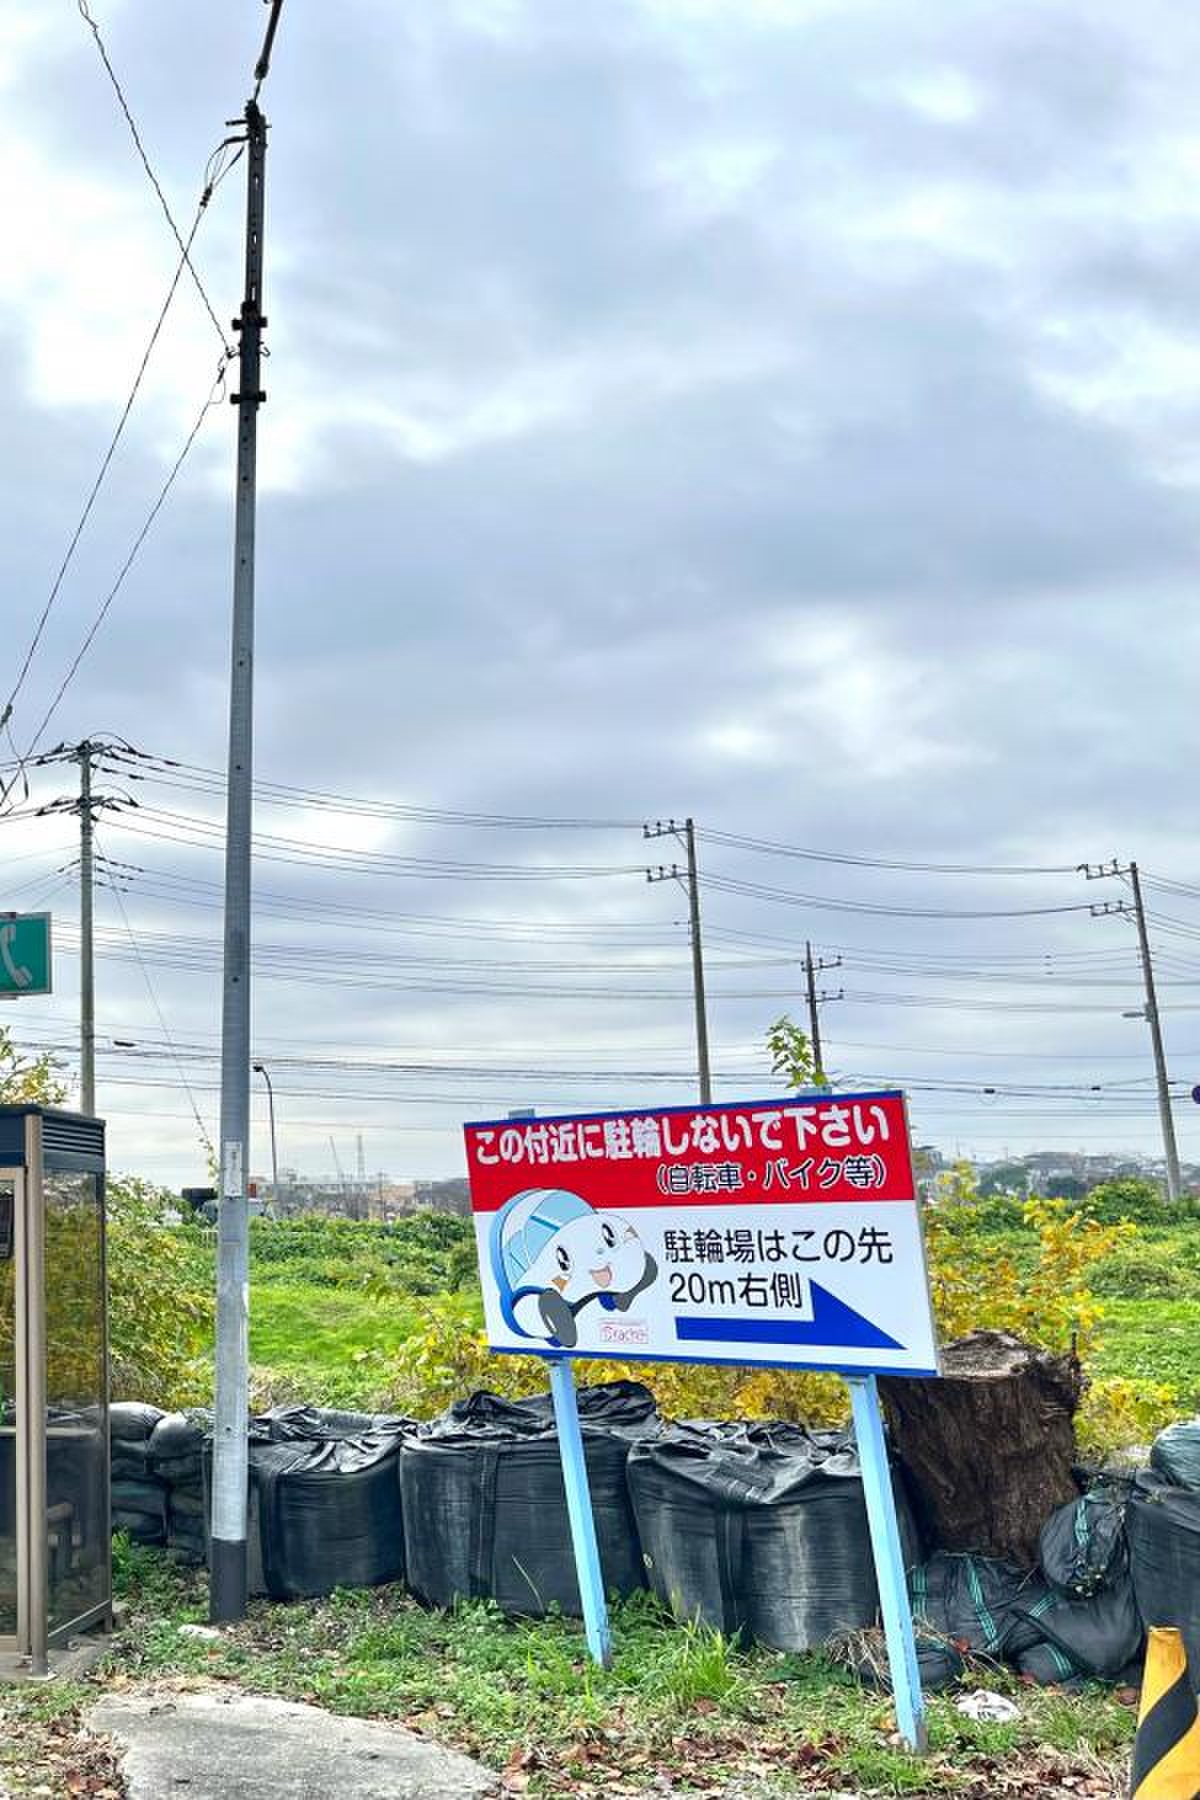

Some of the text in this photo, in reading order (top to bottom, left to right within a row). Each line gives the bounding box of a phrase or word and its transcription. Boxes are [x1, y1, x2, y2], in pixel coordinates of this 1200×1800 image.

[475, 1104, 890, 1166] この付近に駐輪しないで下さい
[663, 1228, 894, 1265] 駐輪場はこの先
[668, 1272, 802, 1309] 20m右側
